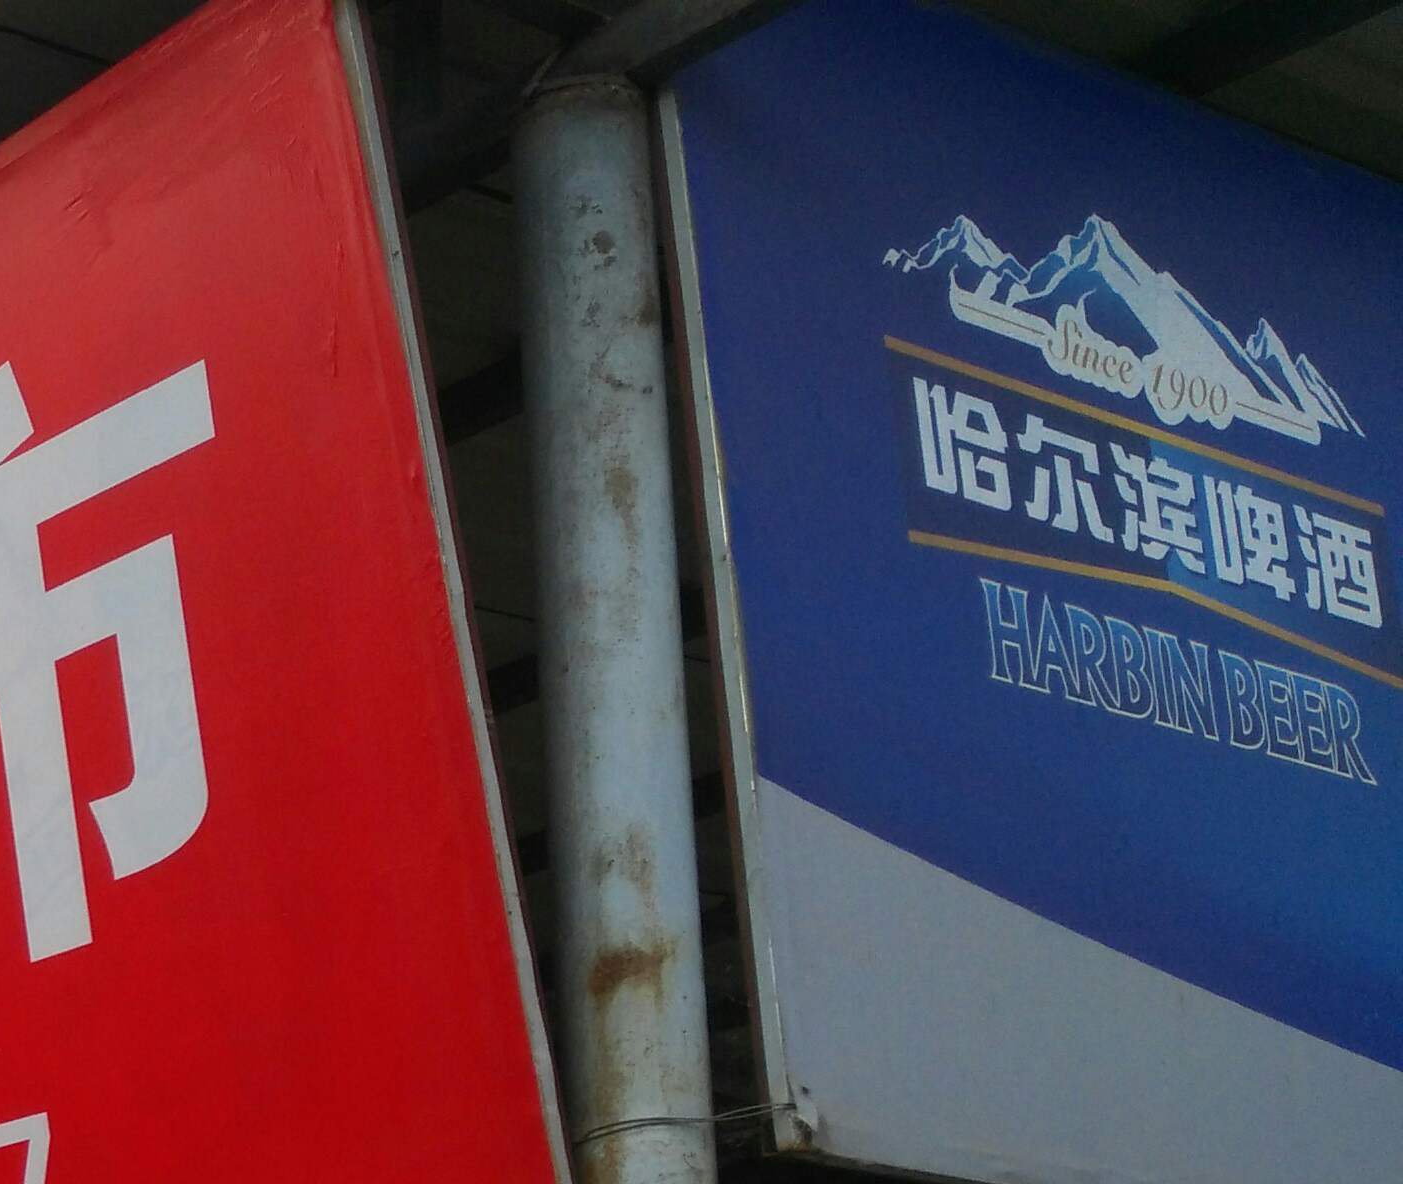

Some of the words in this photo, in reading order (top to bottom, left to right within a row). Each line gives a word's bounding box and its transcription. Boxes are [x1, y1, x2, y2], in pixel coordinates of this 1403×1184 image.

[1048, 319, 1133, 385] Since
[1152, 363, 1229, 416] 1900
[912, 376, 1383, 629] 哈尔滨啤酒
[979, 577, 1219, 741] HARBIN
[1217, 649, 1378, 786] BEER
